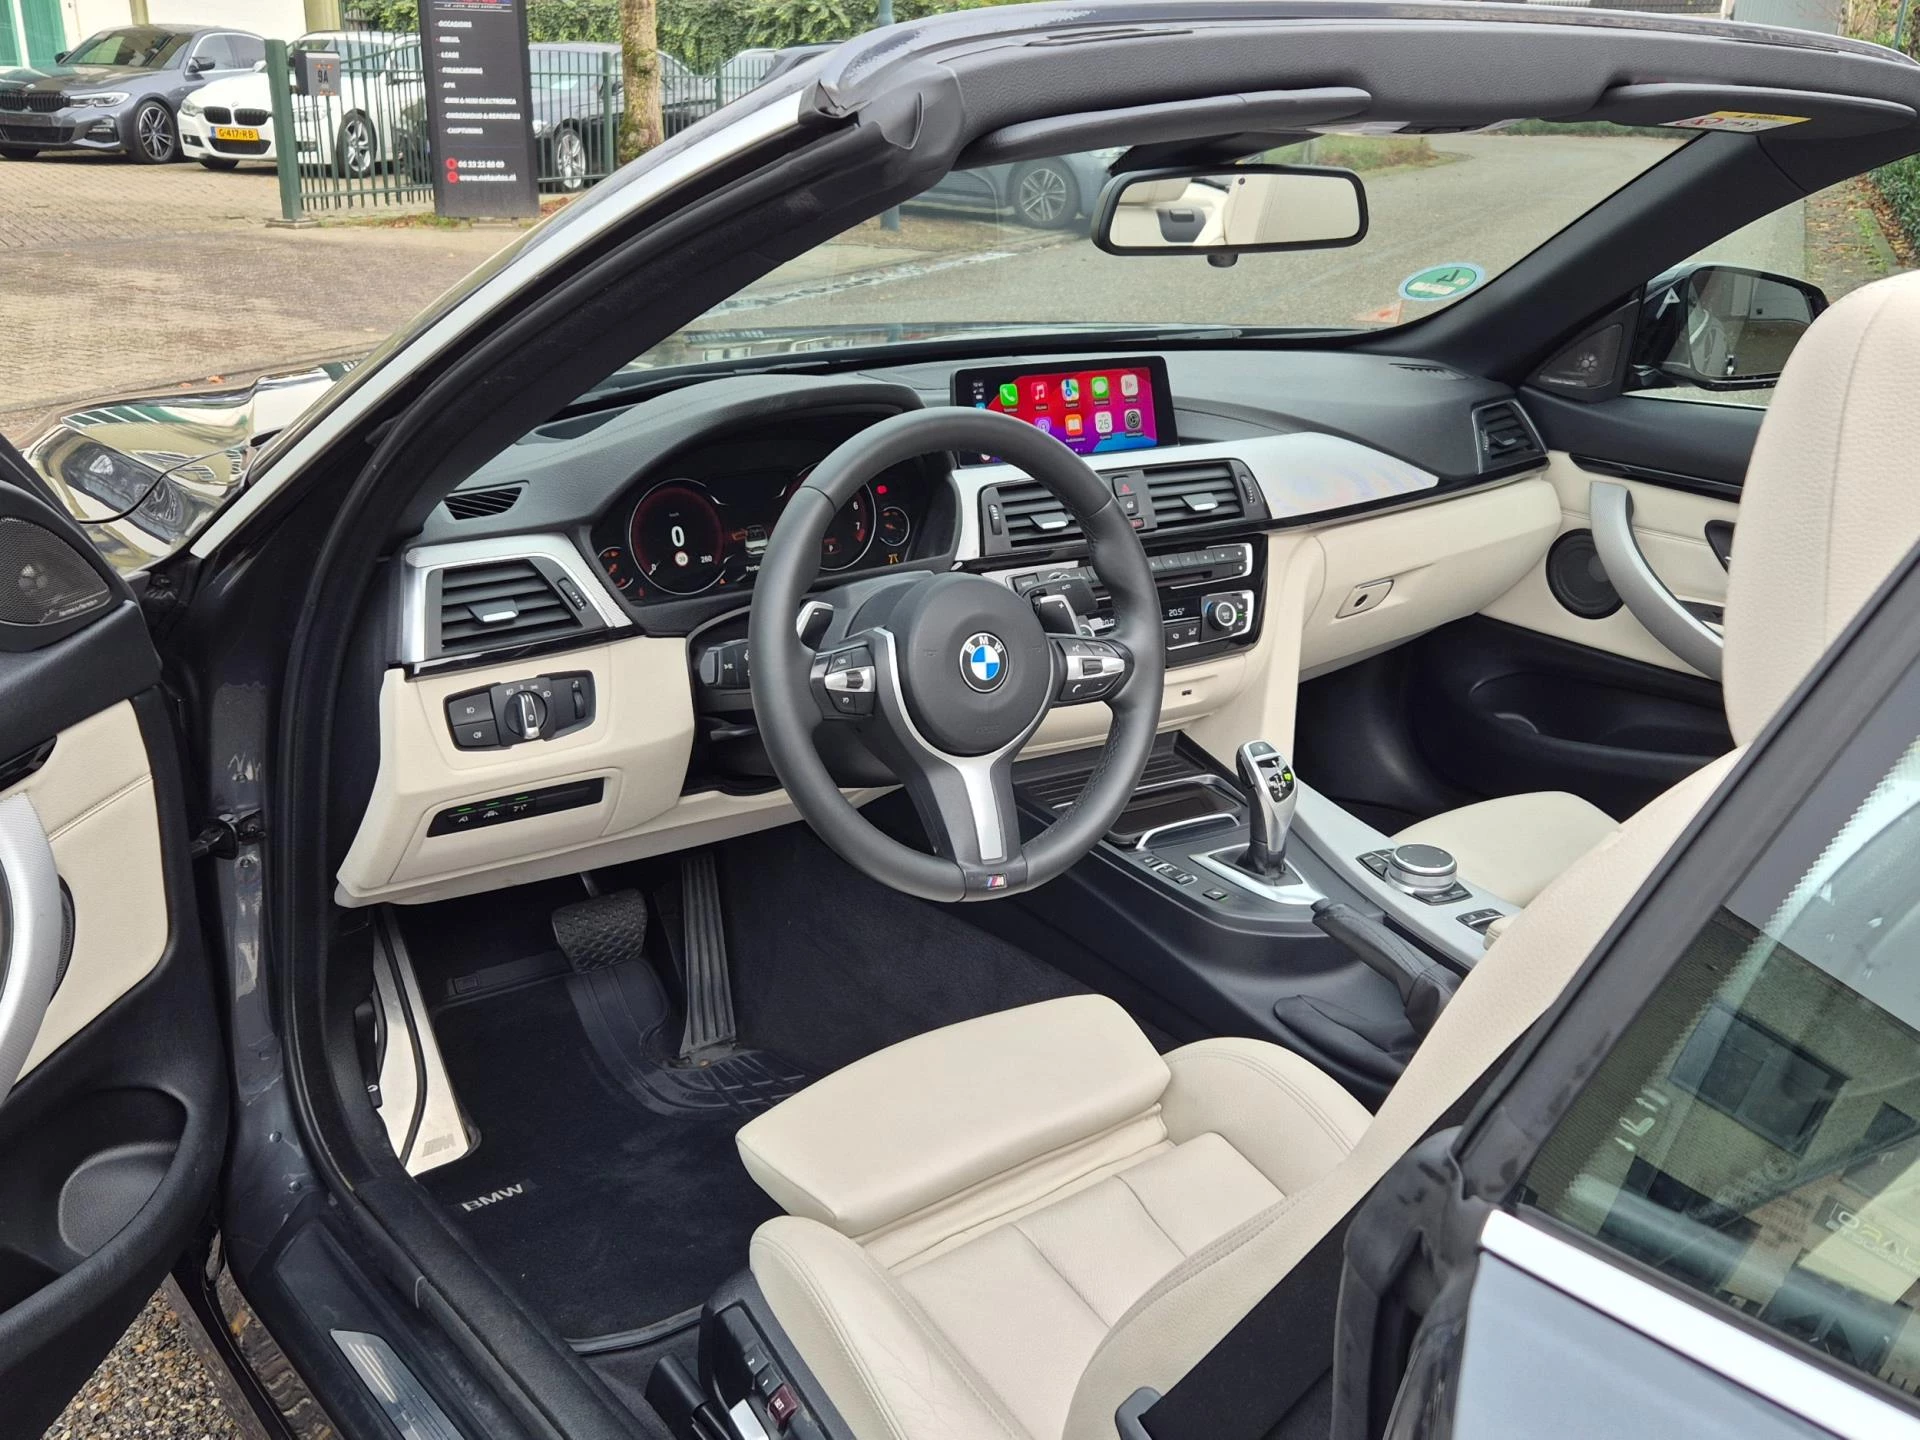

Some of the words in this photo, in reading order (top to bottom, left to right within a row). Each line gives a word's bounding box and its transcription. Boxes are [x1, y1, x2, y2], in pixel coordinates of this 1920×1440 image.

[671, 525, 685, 547] 0
[965, 636, 1003, 654] BMW
[461, 1183, 523, 1212] BMW
